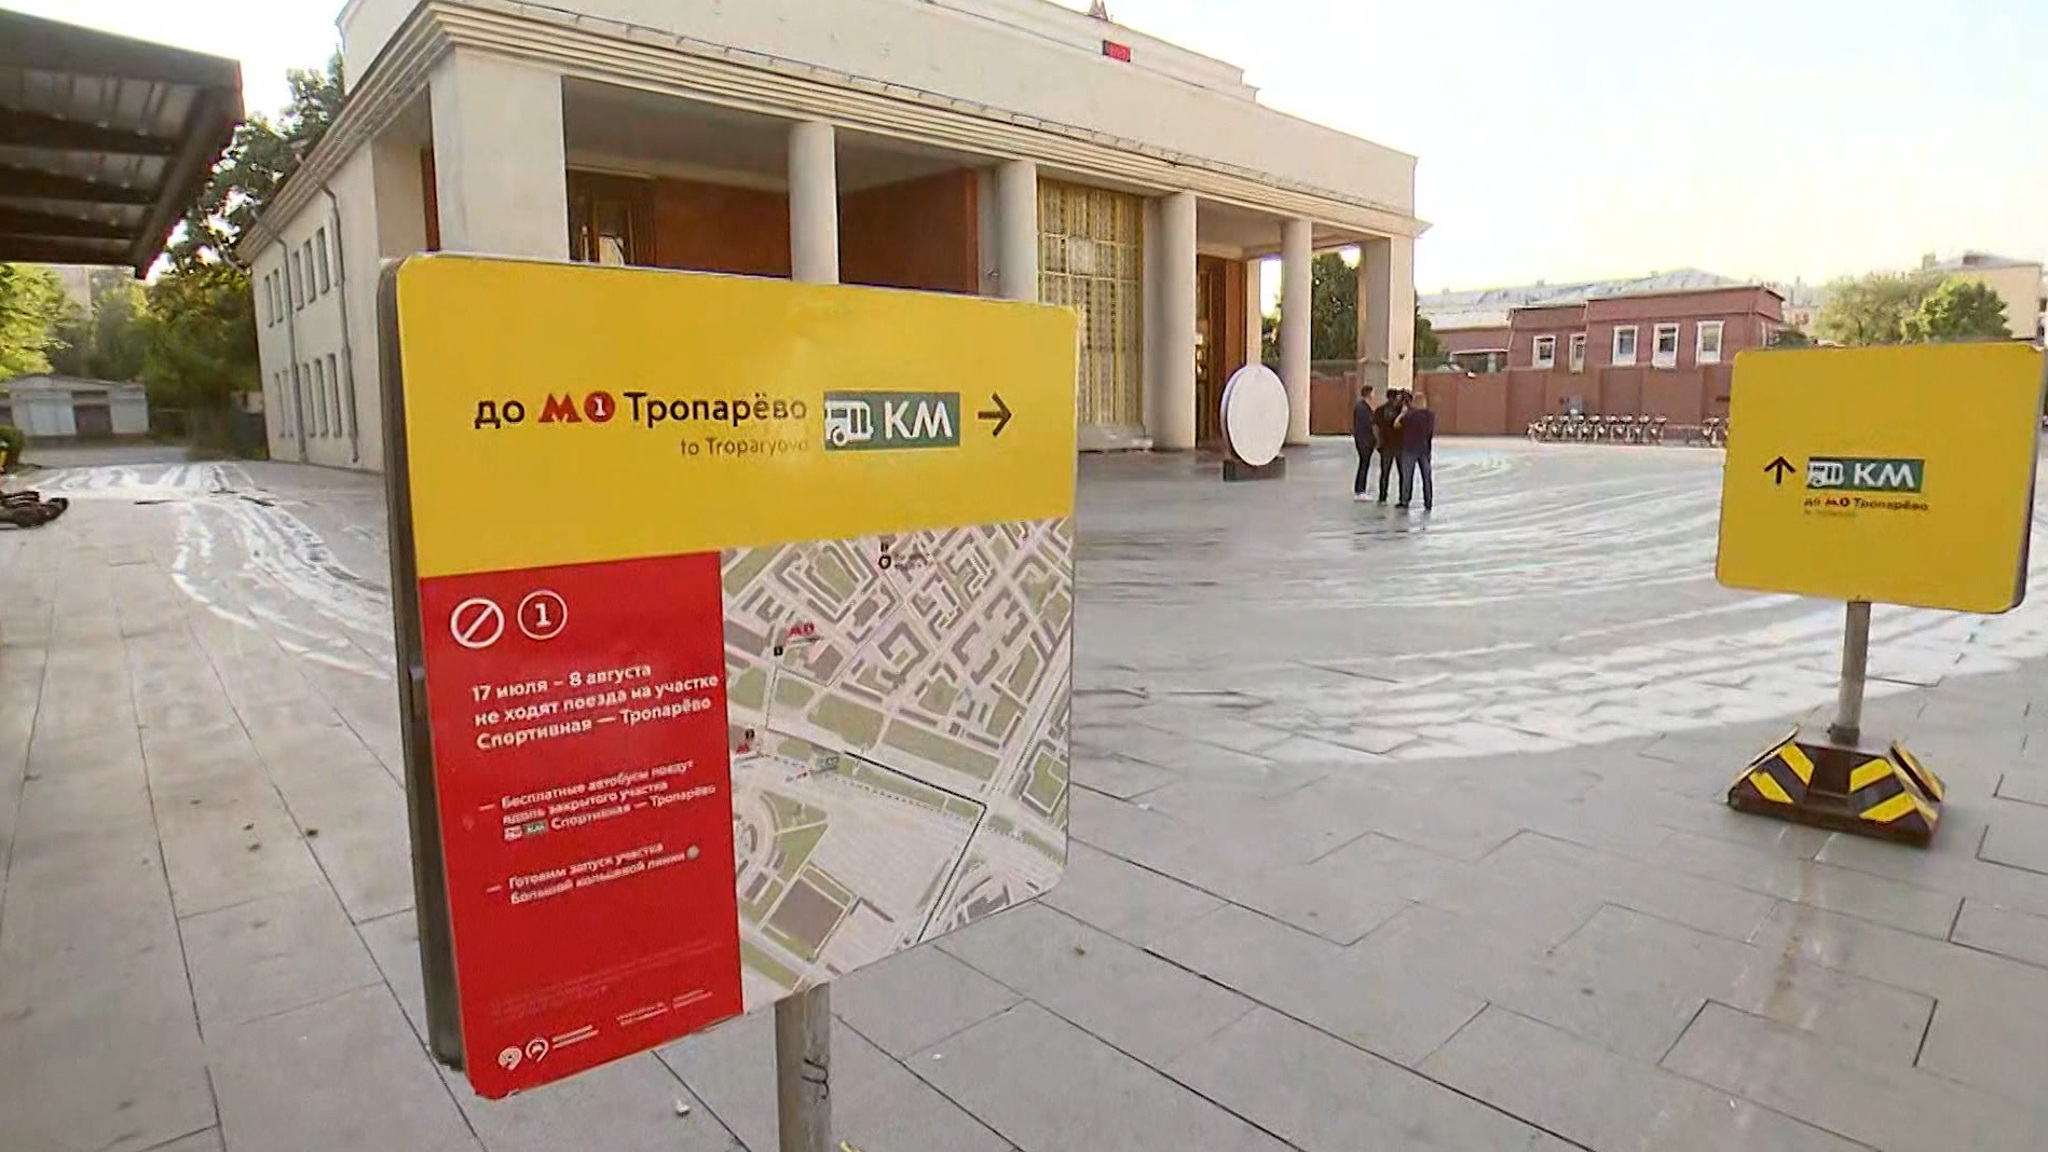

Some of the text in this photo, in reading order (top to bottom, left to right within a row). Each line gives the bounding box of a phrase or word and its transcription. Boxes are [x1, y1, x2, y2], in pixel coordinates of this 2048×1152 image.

[474, 396, 525, 429] до
[623, 391, 807, 427] Тропарёво
[884, 401, 953, 439] КМ
[681, 437, 808, 457] to Troparyovo
[1854, 462, 1916, 488] КМ
[471, 685, 491, 702] 17
[497, 678, 548, 699] июля
[569, 671, 583, 687] 8
[586, 664, 651, 686] августа
[475, 674, 719, 727] не ходят поезда на участке
[476, 718, 592, 750] Спортивная
[620, 697, 711, 726] Тропарёво
[502, 784, 585, 810] Бесплатные
[551, 805, 631, 830] Спортивная
